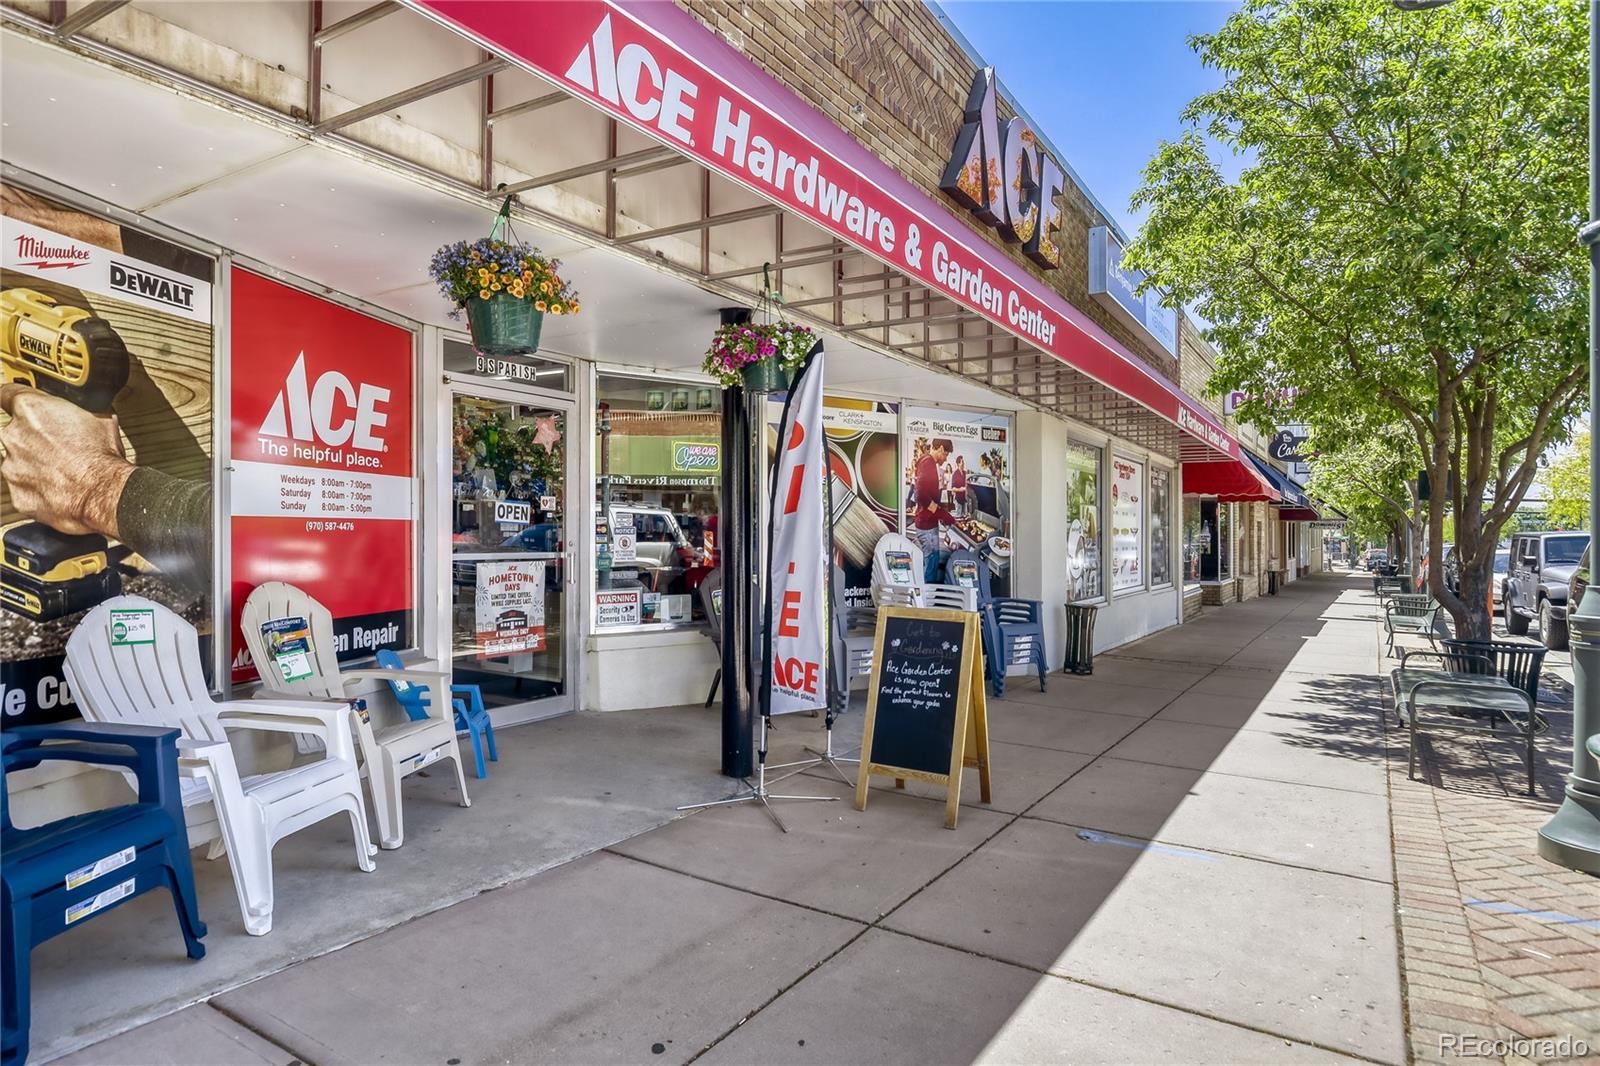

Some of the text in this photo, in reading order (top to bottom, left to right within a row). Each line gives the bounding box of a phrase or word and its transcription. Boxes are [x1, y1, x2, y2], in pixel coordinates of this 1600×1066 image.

[940, 65, 1065, 269] ACE
[564, 12, 1056, 347] ACE Hardware & Garden Center
[14, 234, 90, 260] Milwaukee
[478, 358, 536, 380] 9 S PARISH
[258, 350, 391, 452] ACE
[843, 419, 882, 427] KENSINGTON
[932, 422, 978, 435] Big Green Egg
[257, 438, 383, 468] The helpful place.
[689, 446, 717, 456] we are
[676, 446, 717, 471] Open
[281, 474, 315, 486] Weekdays
[321, 478, 345, 488] 8:00am
[350, 480, 372, 490] 7:00pm
[281, 488, 311, 499] Saturday
[321, 490, 345, 500] 8:00am
[350, 492, 372, 502] 7:00pm
[281, 501, 306, 512] Sunday
[321, 502, 345, 512] 8:00am
[350, 503, 372, 514] 5:00pm
[497, 504, 528, 521] OPEN
[305, 521, 354, 532] (970) 587-4476
[488, 573, 534, 585] HOMETOWN
[505, 583, 520, 591] DAYS
[844, 586, 871, 597] ackers
[598, 594, 636, 603] WARNING
[600, 606, 620, 614] Security
[353, 622, 399, 651] Repair
[773, 652, 819, 694] ACE
[886, 660, 952, 675] Ace Garden Center
[894, 675, 902, 683] is
[37, 676, 76, 710] Cu
[881, 686, 892, 694] Find
[903, 687, 921, 698] perfect
